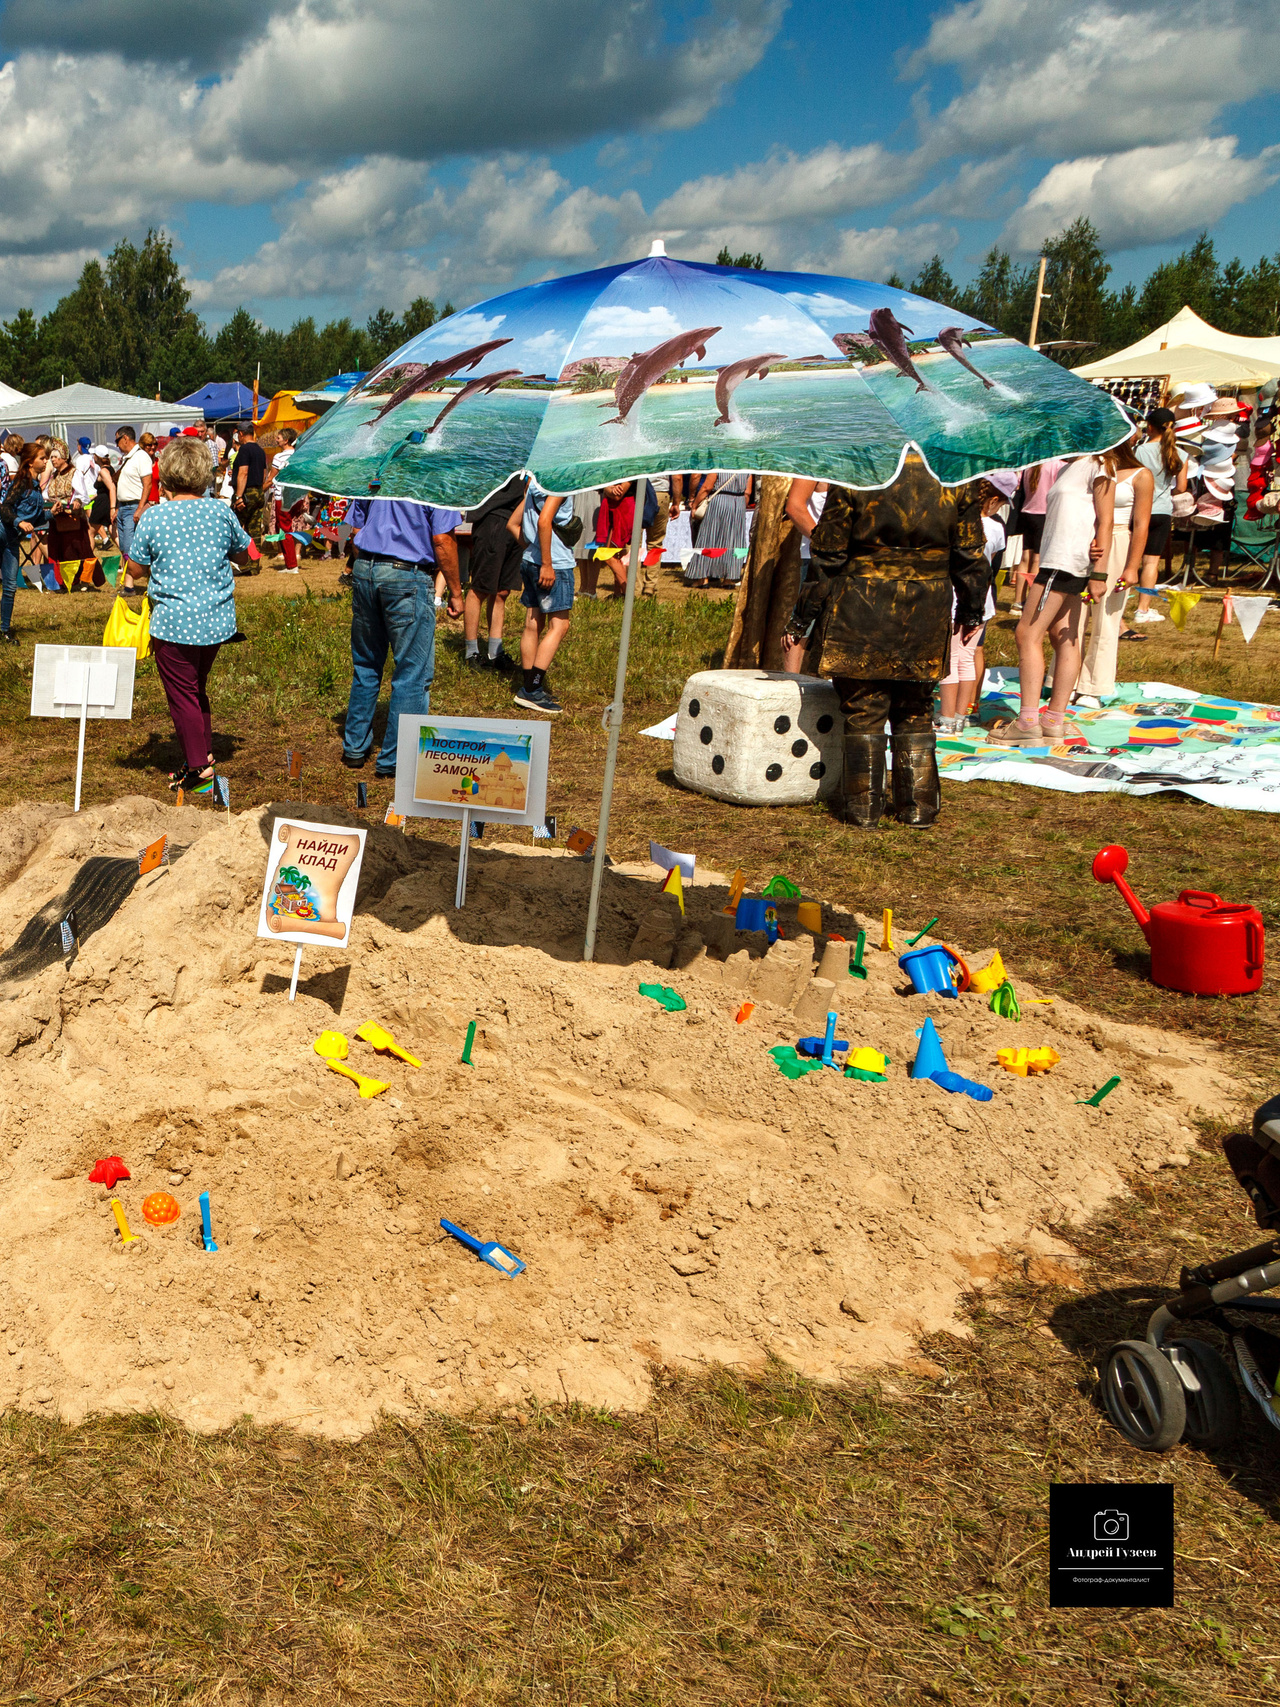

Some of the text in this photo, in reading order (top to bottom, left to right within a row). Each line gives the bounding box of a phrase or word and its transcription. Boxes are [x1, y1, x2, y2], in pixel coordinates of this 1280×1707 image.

[431, 738, 487, 752] ПОСТРОЙ
[424, 750, 491, 765] ПЕСОЧНЫЙ
[432, 763, 478, 777] ЗАМОК
[296, 838, 349, 856] НАЙДИ
[298, 853, 338, 872] КЛАД
